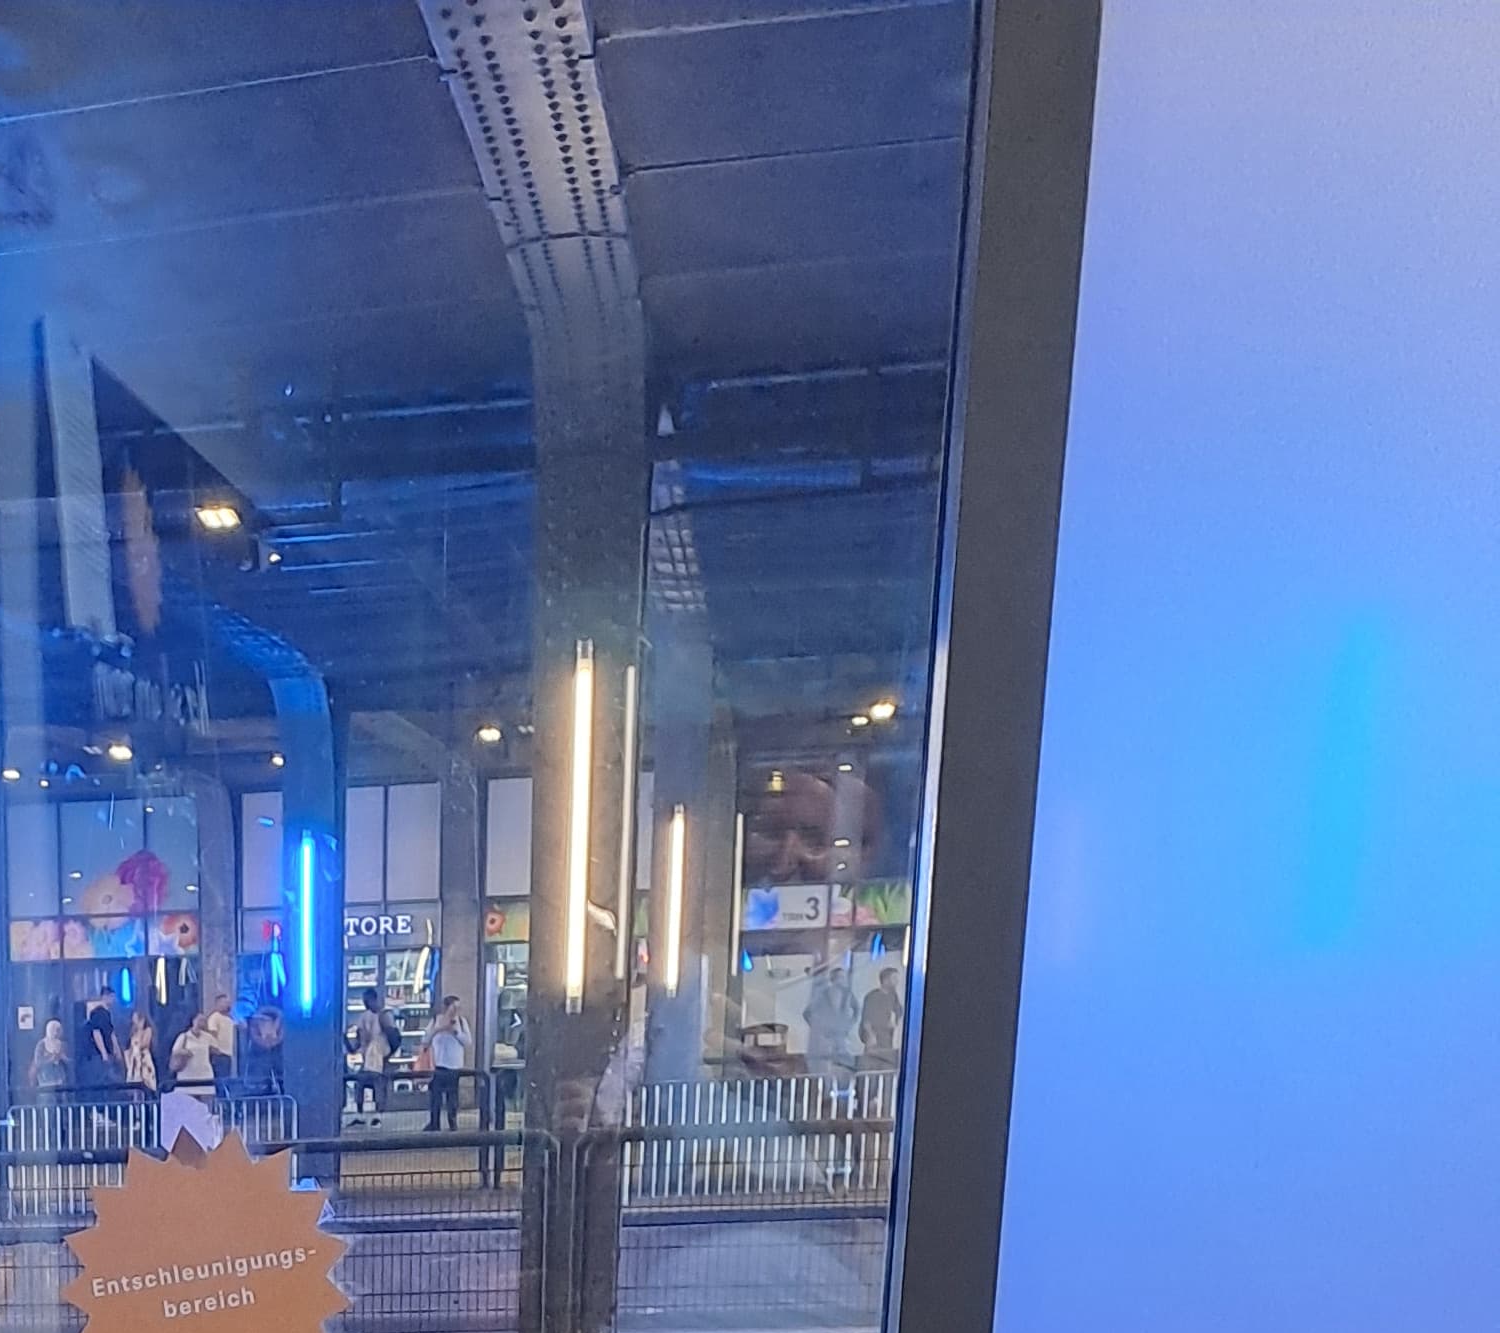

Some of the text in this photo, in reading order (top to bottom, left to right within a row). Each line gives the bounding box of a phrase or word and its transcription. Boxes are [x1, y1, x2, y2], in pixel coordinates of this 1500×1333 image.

[345, 915, 412, 936] TORE
[91, 1246, 317, 1297] Entschleunigungs-
[163, 1288, 256, 1318] bereich
